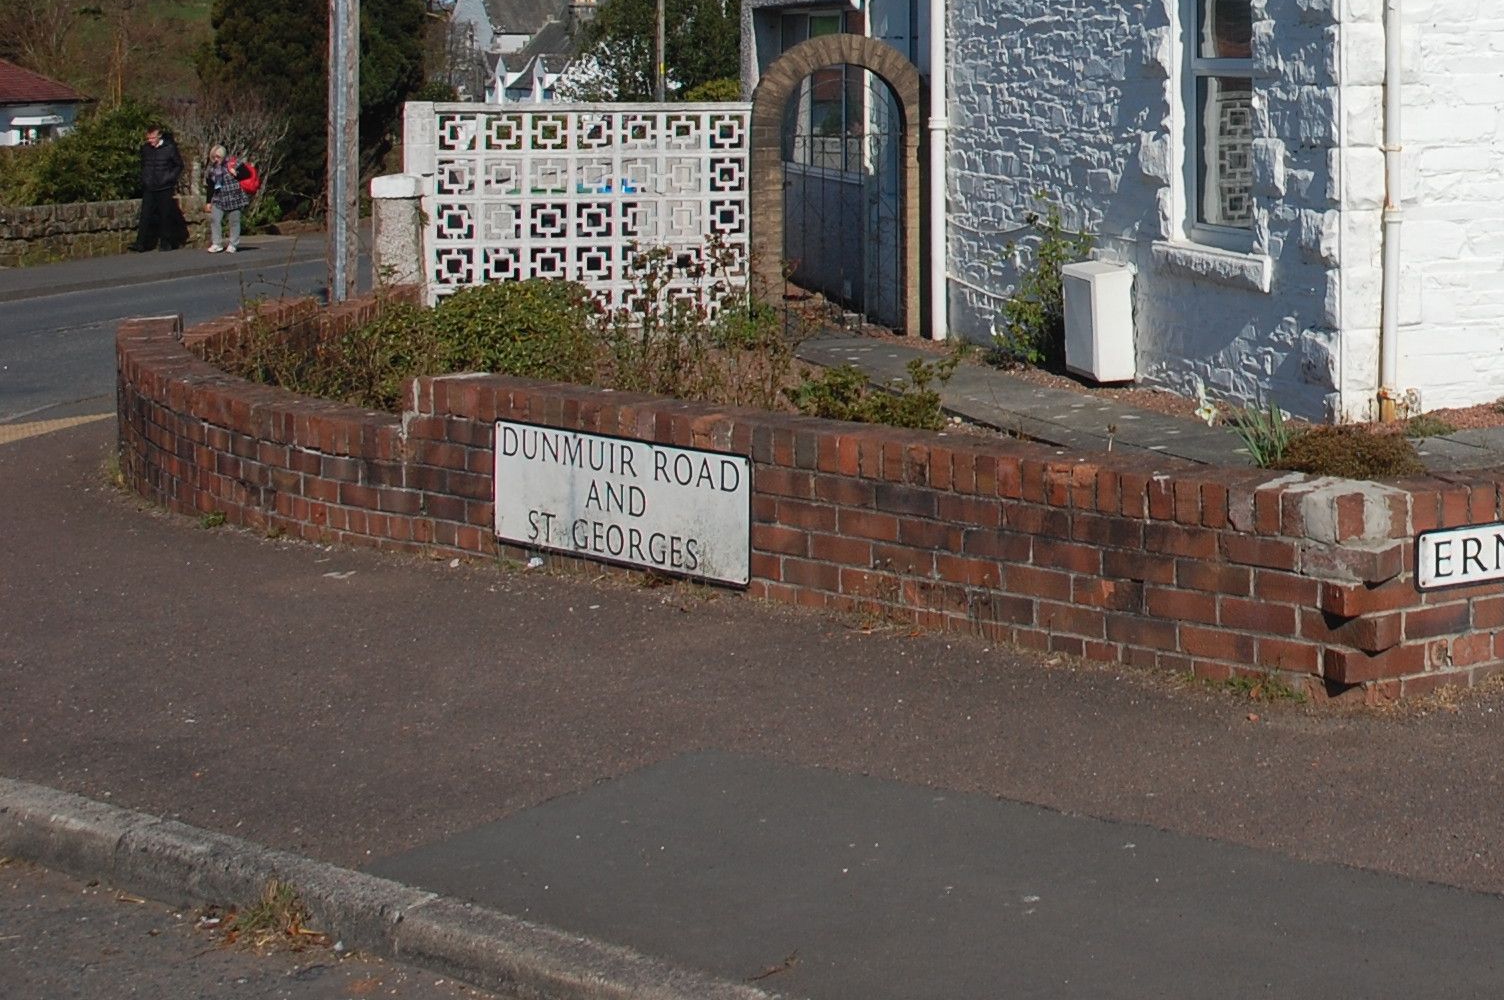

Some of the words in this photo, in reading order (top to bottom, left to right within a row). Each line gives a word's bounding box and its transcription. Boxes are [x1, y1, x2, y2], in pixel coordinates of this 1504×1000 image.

[502, 426, 638, 478] DUNMUIR
[654, 450, 740, 493] ROAD
[585, 479, 647, 517] AND
[528, 510, 556, 543] ST
[571, 518, 699, 571] GEORGES
